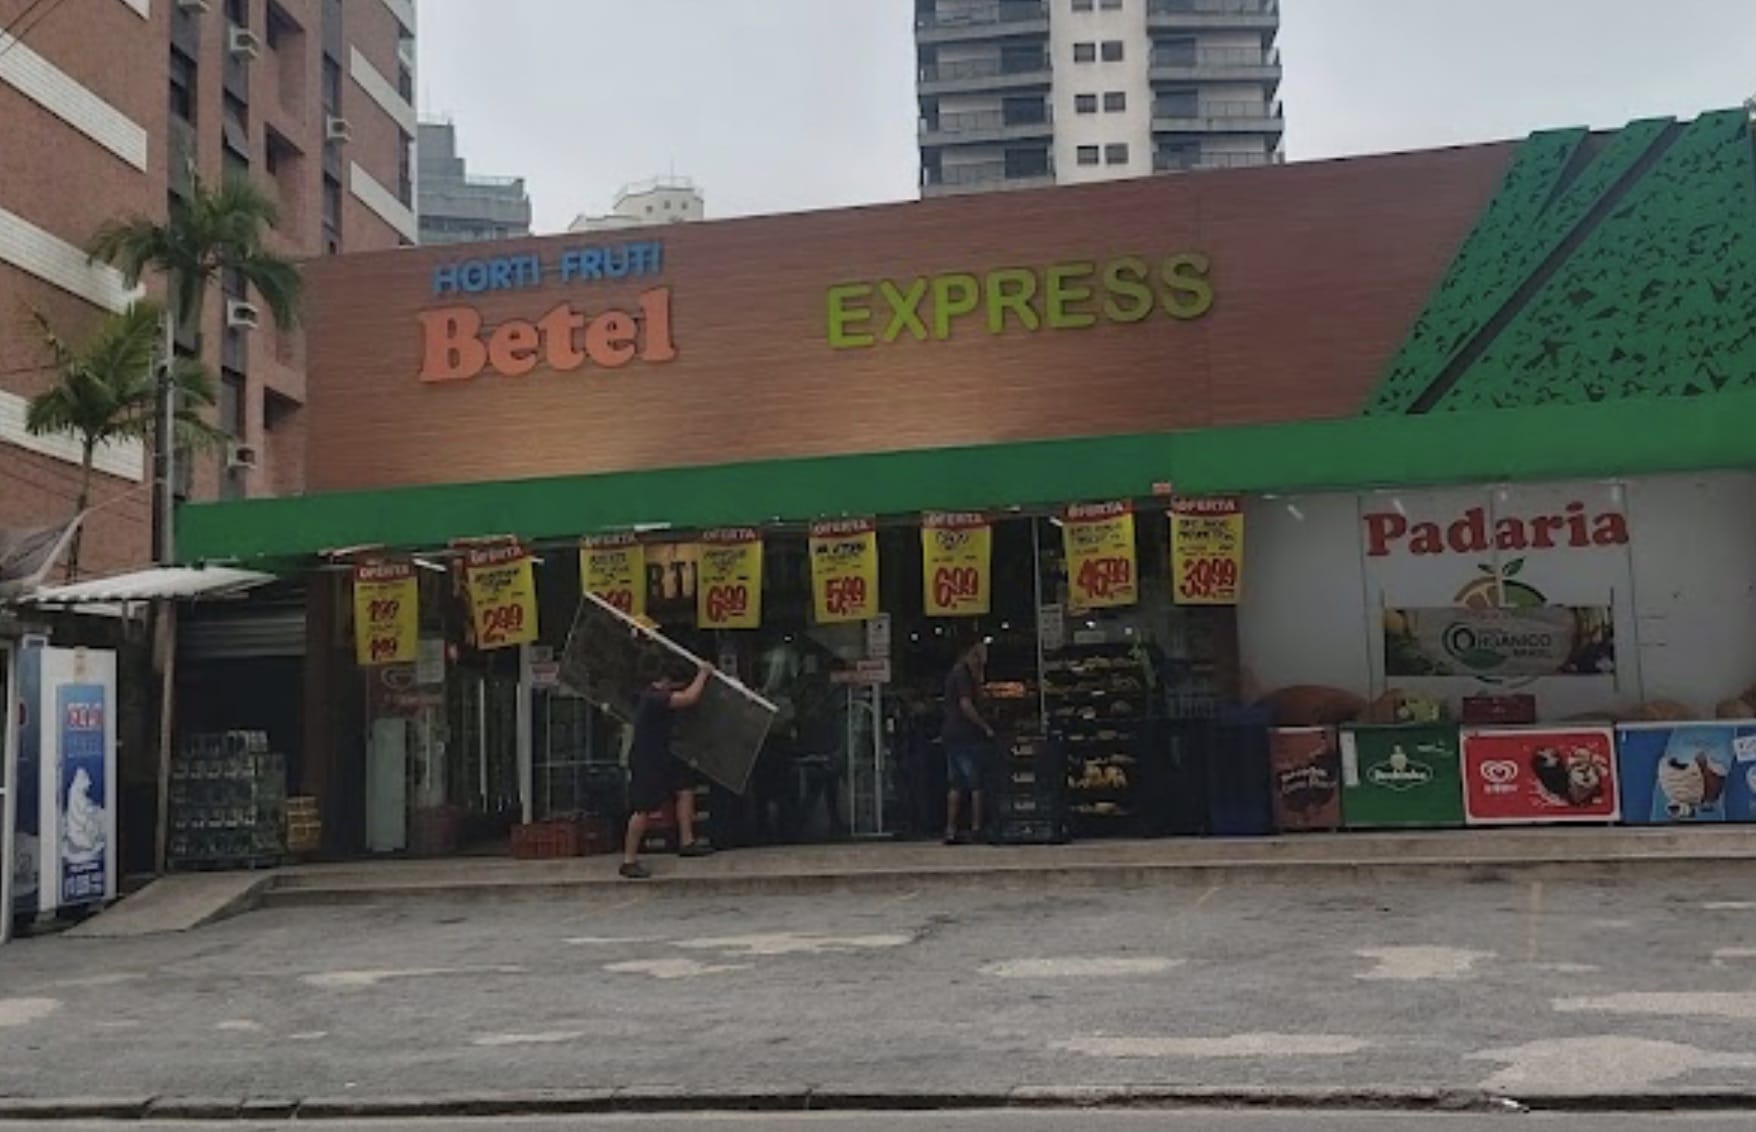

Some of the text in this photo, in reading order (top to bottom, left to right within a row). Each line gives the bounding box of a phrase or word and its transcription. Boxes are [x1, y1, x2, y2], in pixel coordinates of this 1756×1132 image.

[431, 242, 664, 296] HORTI FRUTI
[825, 253, 1215, 351] EXPRESS
[418, 288, 678, 384] Betel
[1364, 502, 1629, 556] Padaria
